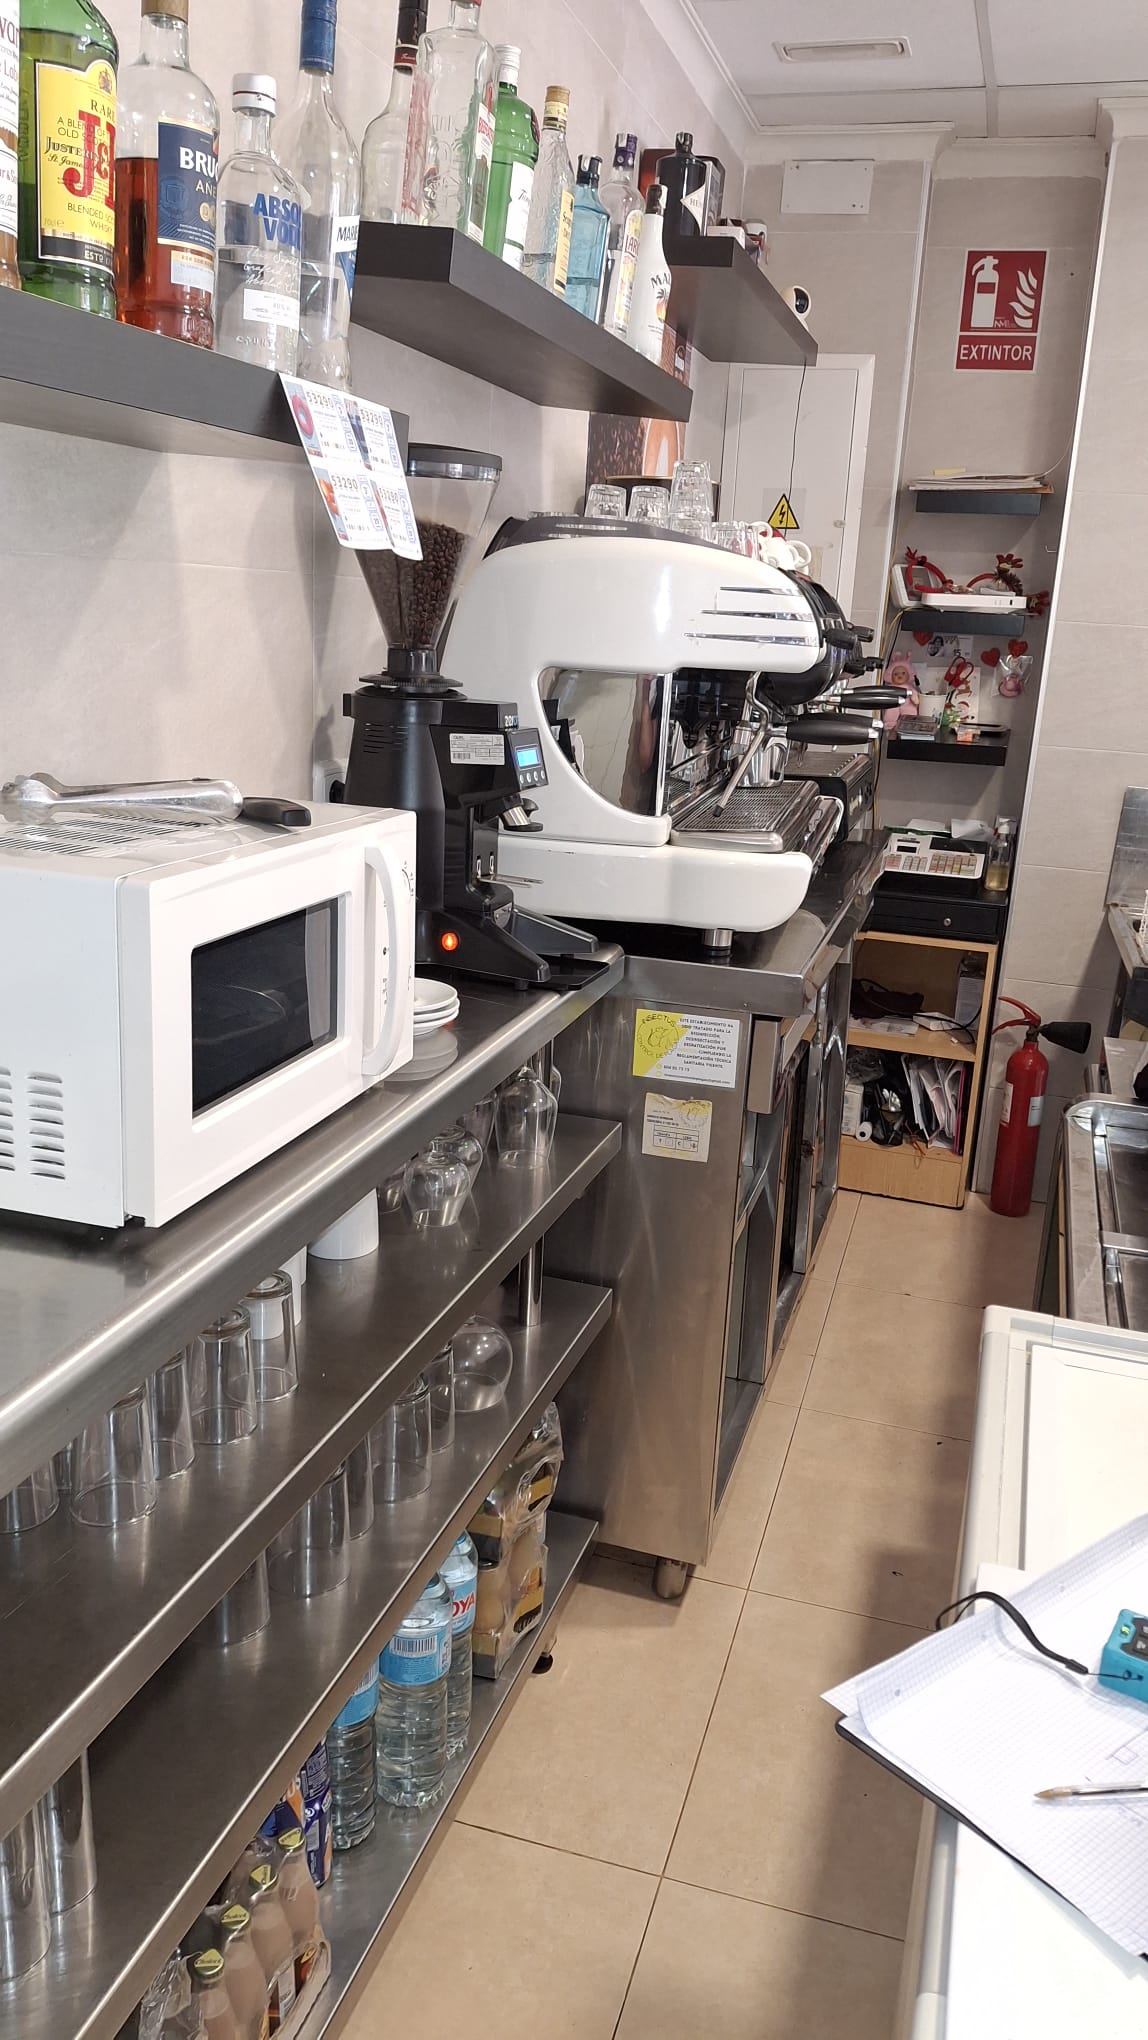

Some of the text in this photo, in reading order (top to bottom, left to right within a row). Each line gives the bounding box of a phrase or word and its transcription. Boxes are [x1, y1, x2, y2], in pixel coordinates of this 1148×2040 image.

[58, 127, 79, 139] OLD
[67, 202, 104, 219] BLENDED
[960, 344, 1032, 361] EXTINTOR
